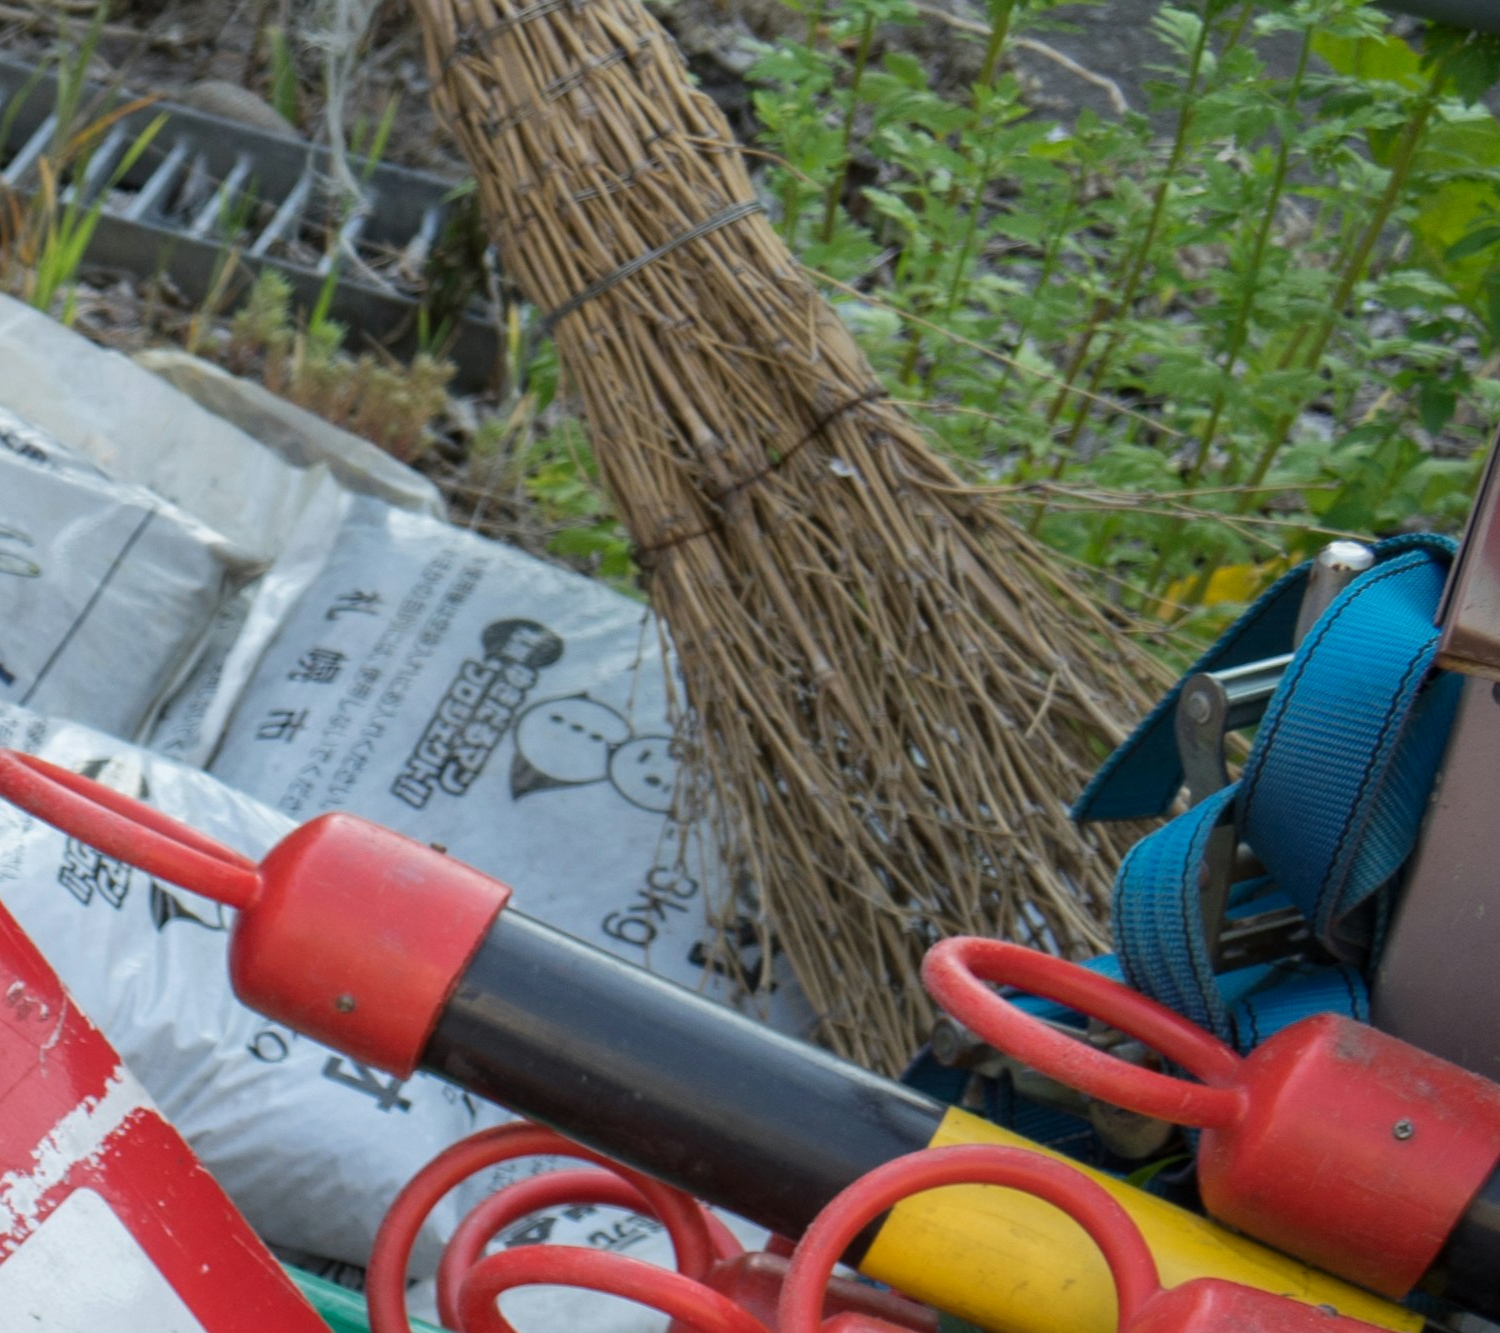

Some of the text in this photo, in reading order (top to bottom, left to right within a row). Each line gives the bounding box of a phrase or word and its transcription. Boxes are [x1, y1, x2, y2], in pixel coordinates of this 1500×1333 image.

[255, 588, 382, 743] 札幌市
[603, 870, 699, 951] 3kg
